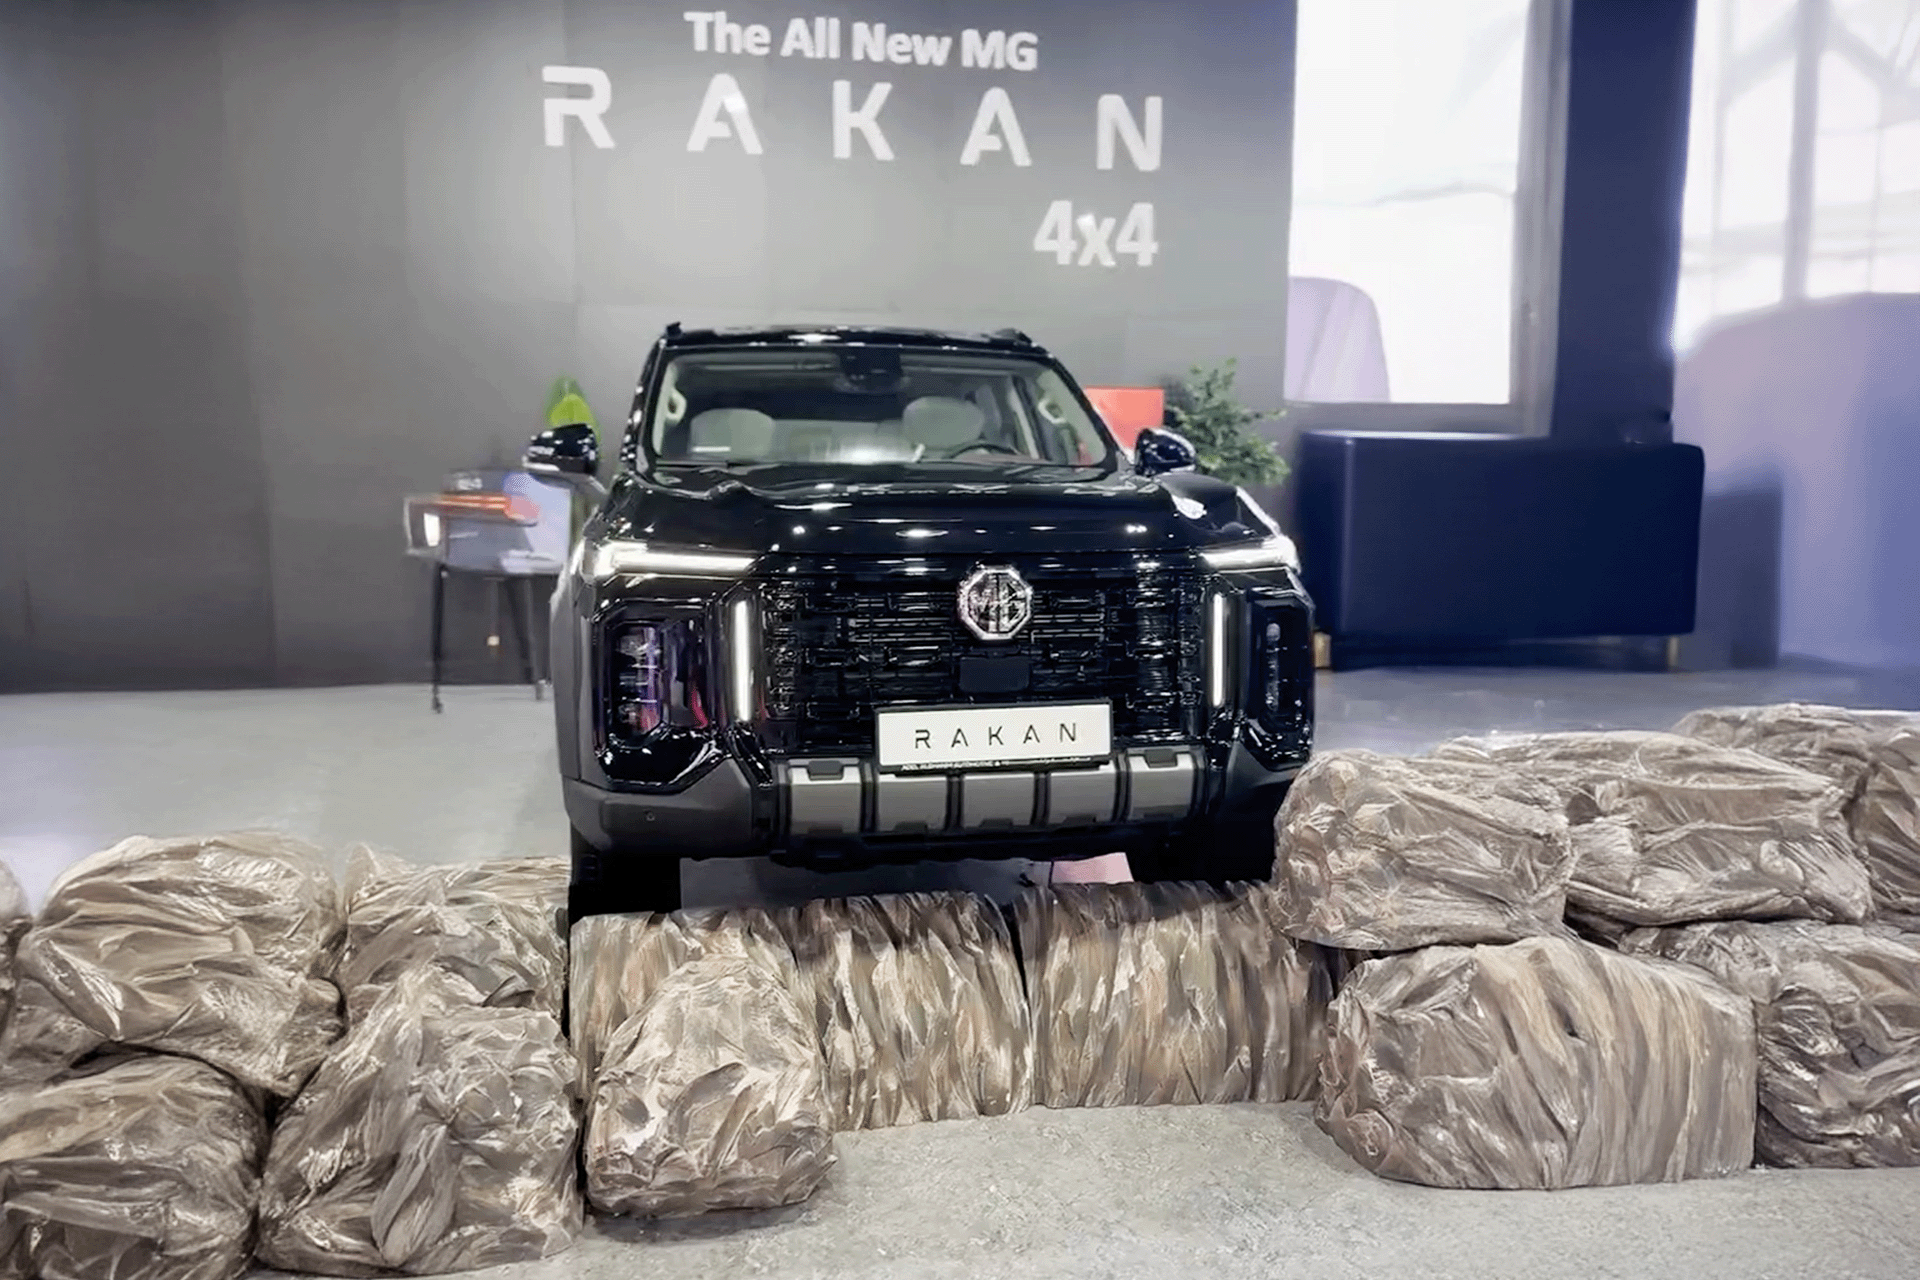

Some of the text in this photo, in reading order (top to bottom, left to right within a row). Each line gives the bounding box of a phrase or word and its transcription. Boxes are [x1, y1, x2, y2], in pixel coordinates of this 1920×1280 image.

[684, 11, 1039, 72] The All New MG
[541, 66, 1164, 172] RAKAN
[1034, 200, 1159, 267] 4x4
[914, 722, 1077, 749] RAKAN
